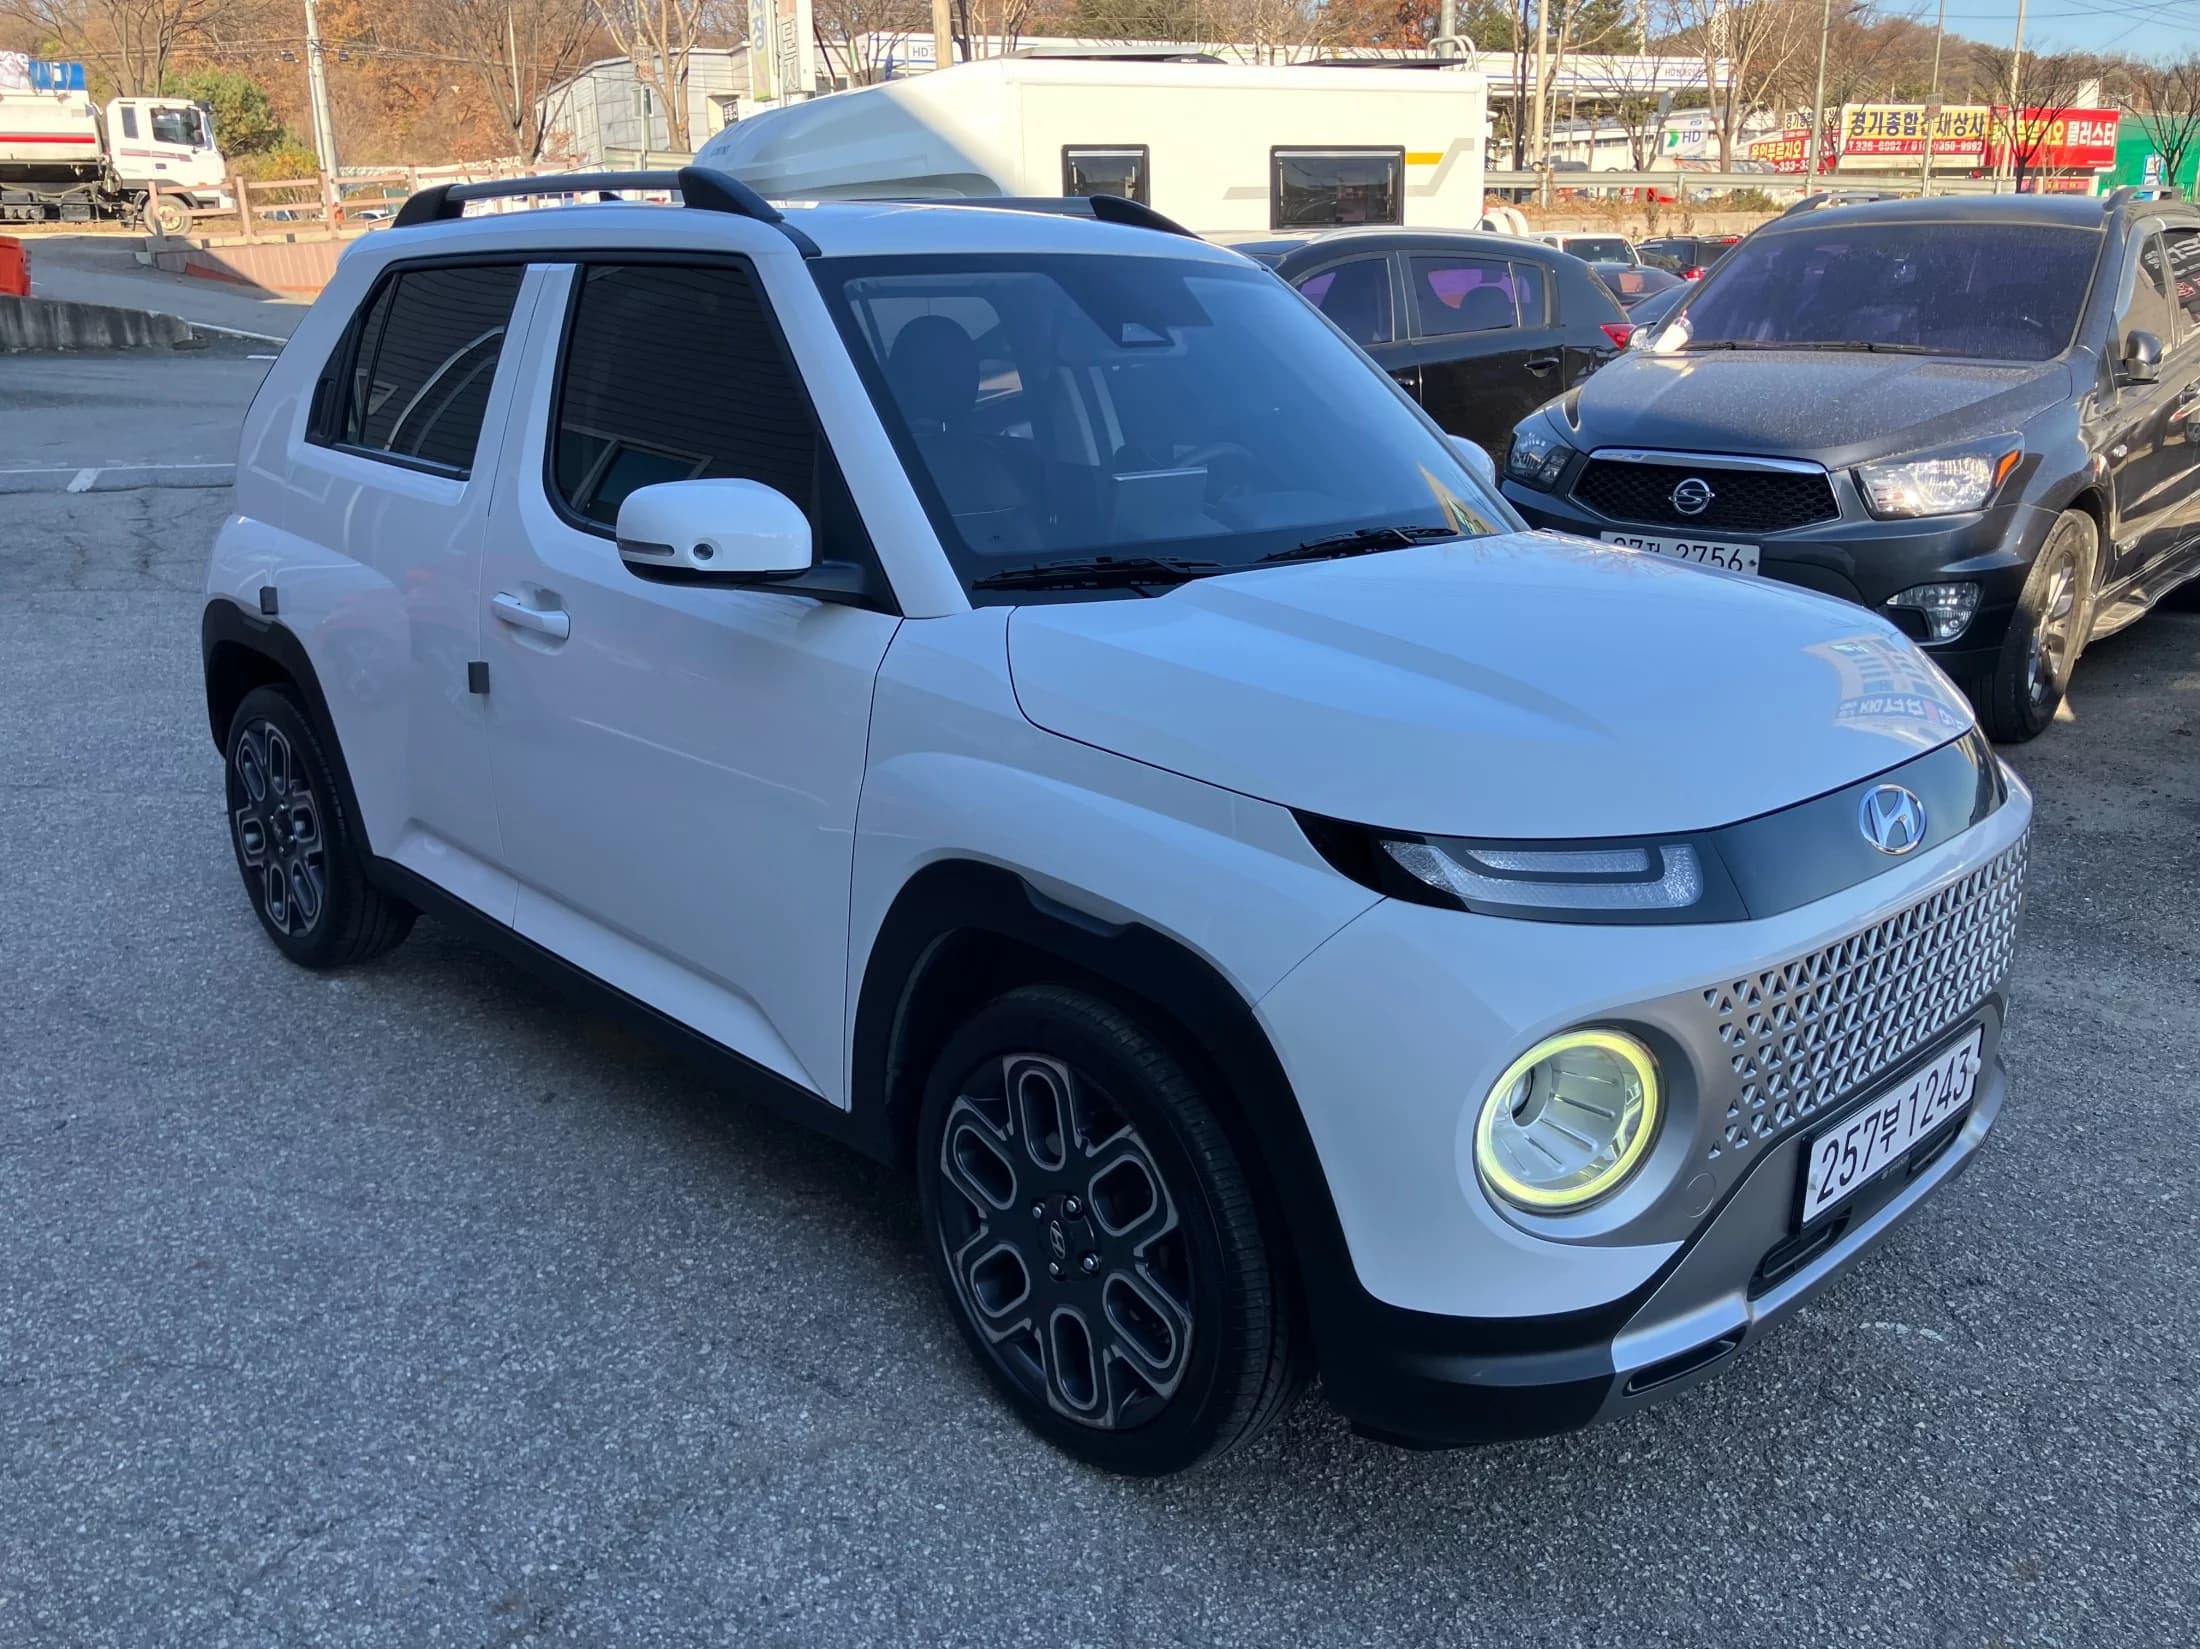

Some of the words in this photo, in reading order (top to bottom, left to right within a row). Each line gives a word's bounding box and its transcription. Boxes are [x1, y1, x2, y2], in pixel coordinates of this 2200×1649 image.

[1682, 131, 1701, 143] HD
[2067, 121, 2116, 146] 클러스터
[1675, 543, 1744, 572] 2756
[1816, 1098, 1901, 1205] 257부
[1908, 1044, 1973, 1138] 1243
